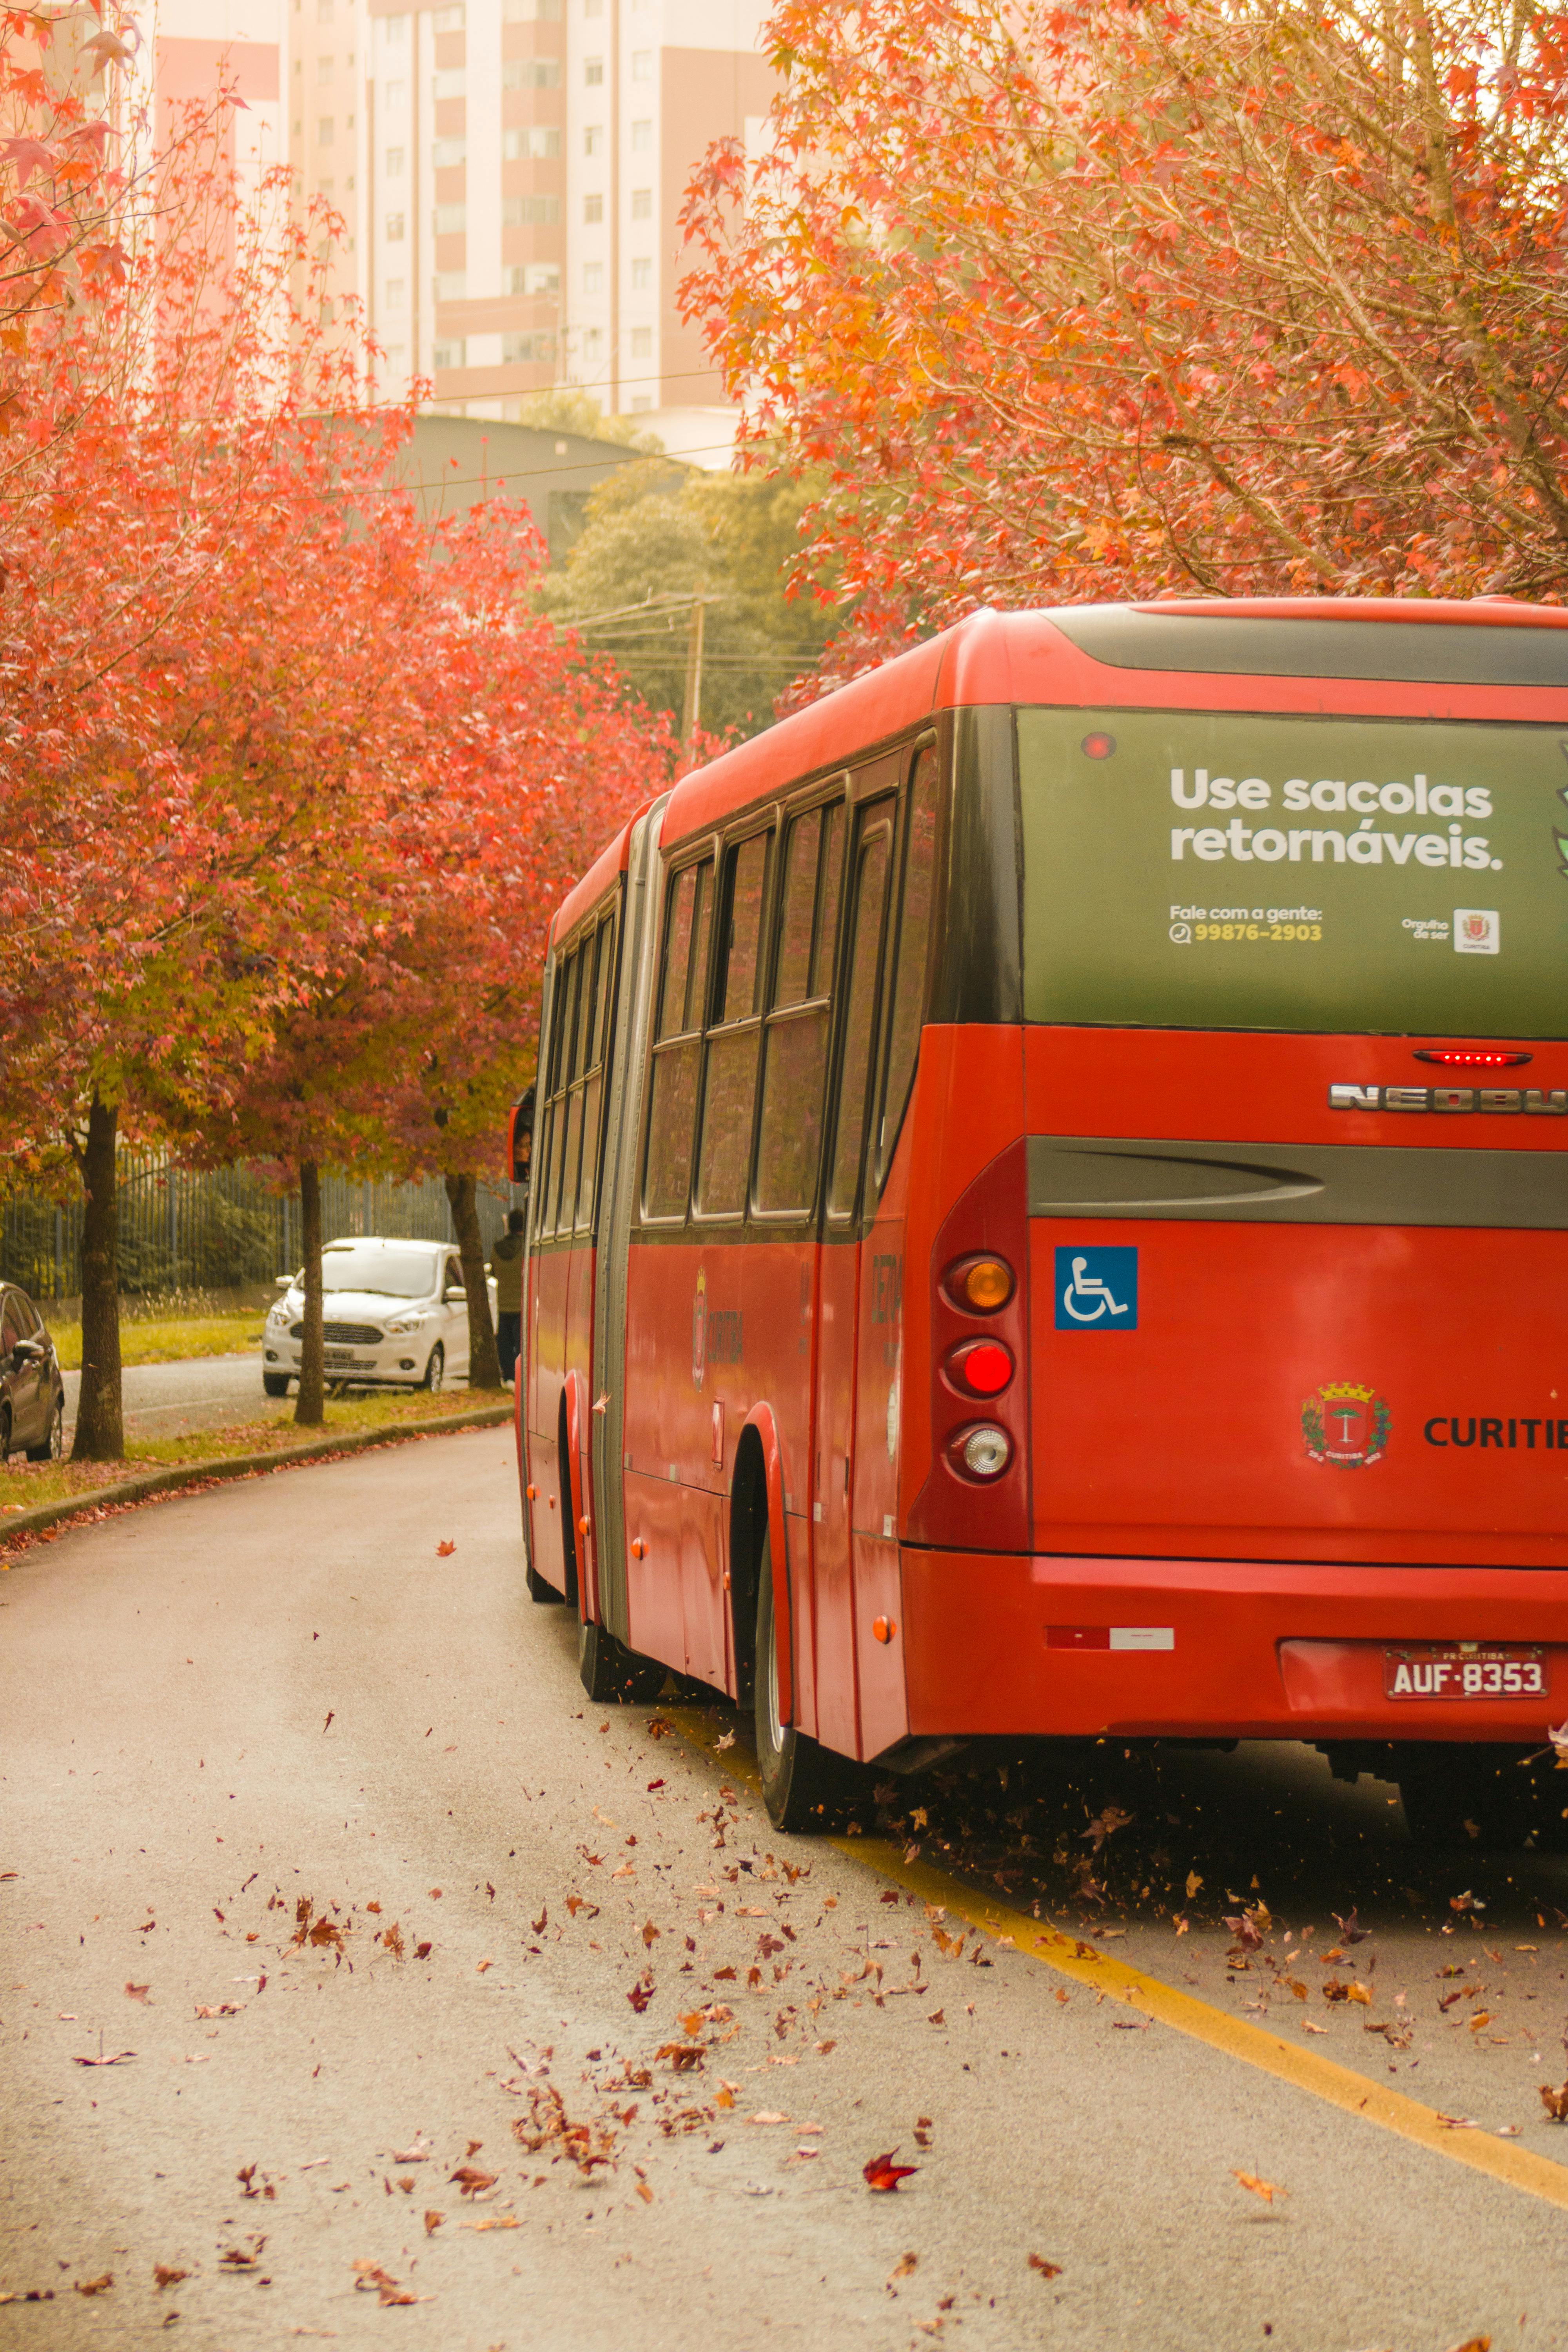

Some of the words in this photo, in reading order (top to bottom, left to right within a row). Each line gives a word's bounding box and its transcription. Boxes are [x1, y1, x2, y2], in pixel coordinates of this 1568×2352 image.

[1171, 769, 1271, 810] Use
[1283, 774, 1493, 819] sacolas
[1171, 818, 1503, 871] retornáveis.
[1170, 905, 1207, 920] Fale
[1209, 908, 1249, 920] com
[1250, 908, 1264, 920] a
[1266, 906, 1323, 924] gente:
[1196, 924, 1322, 942] 99876-2903
[1401, 918, 1449, 931] Orgulho
[1413, 929, 1429, 939] de
[1430, 931, 1450, 940] ser
[1329, 1083, 1568, 1114] NEOBU
